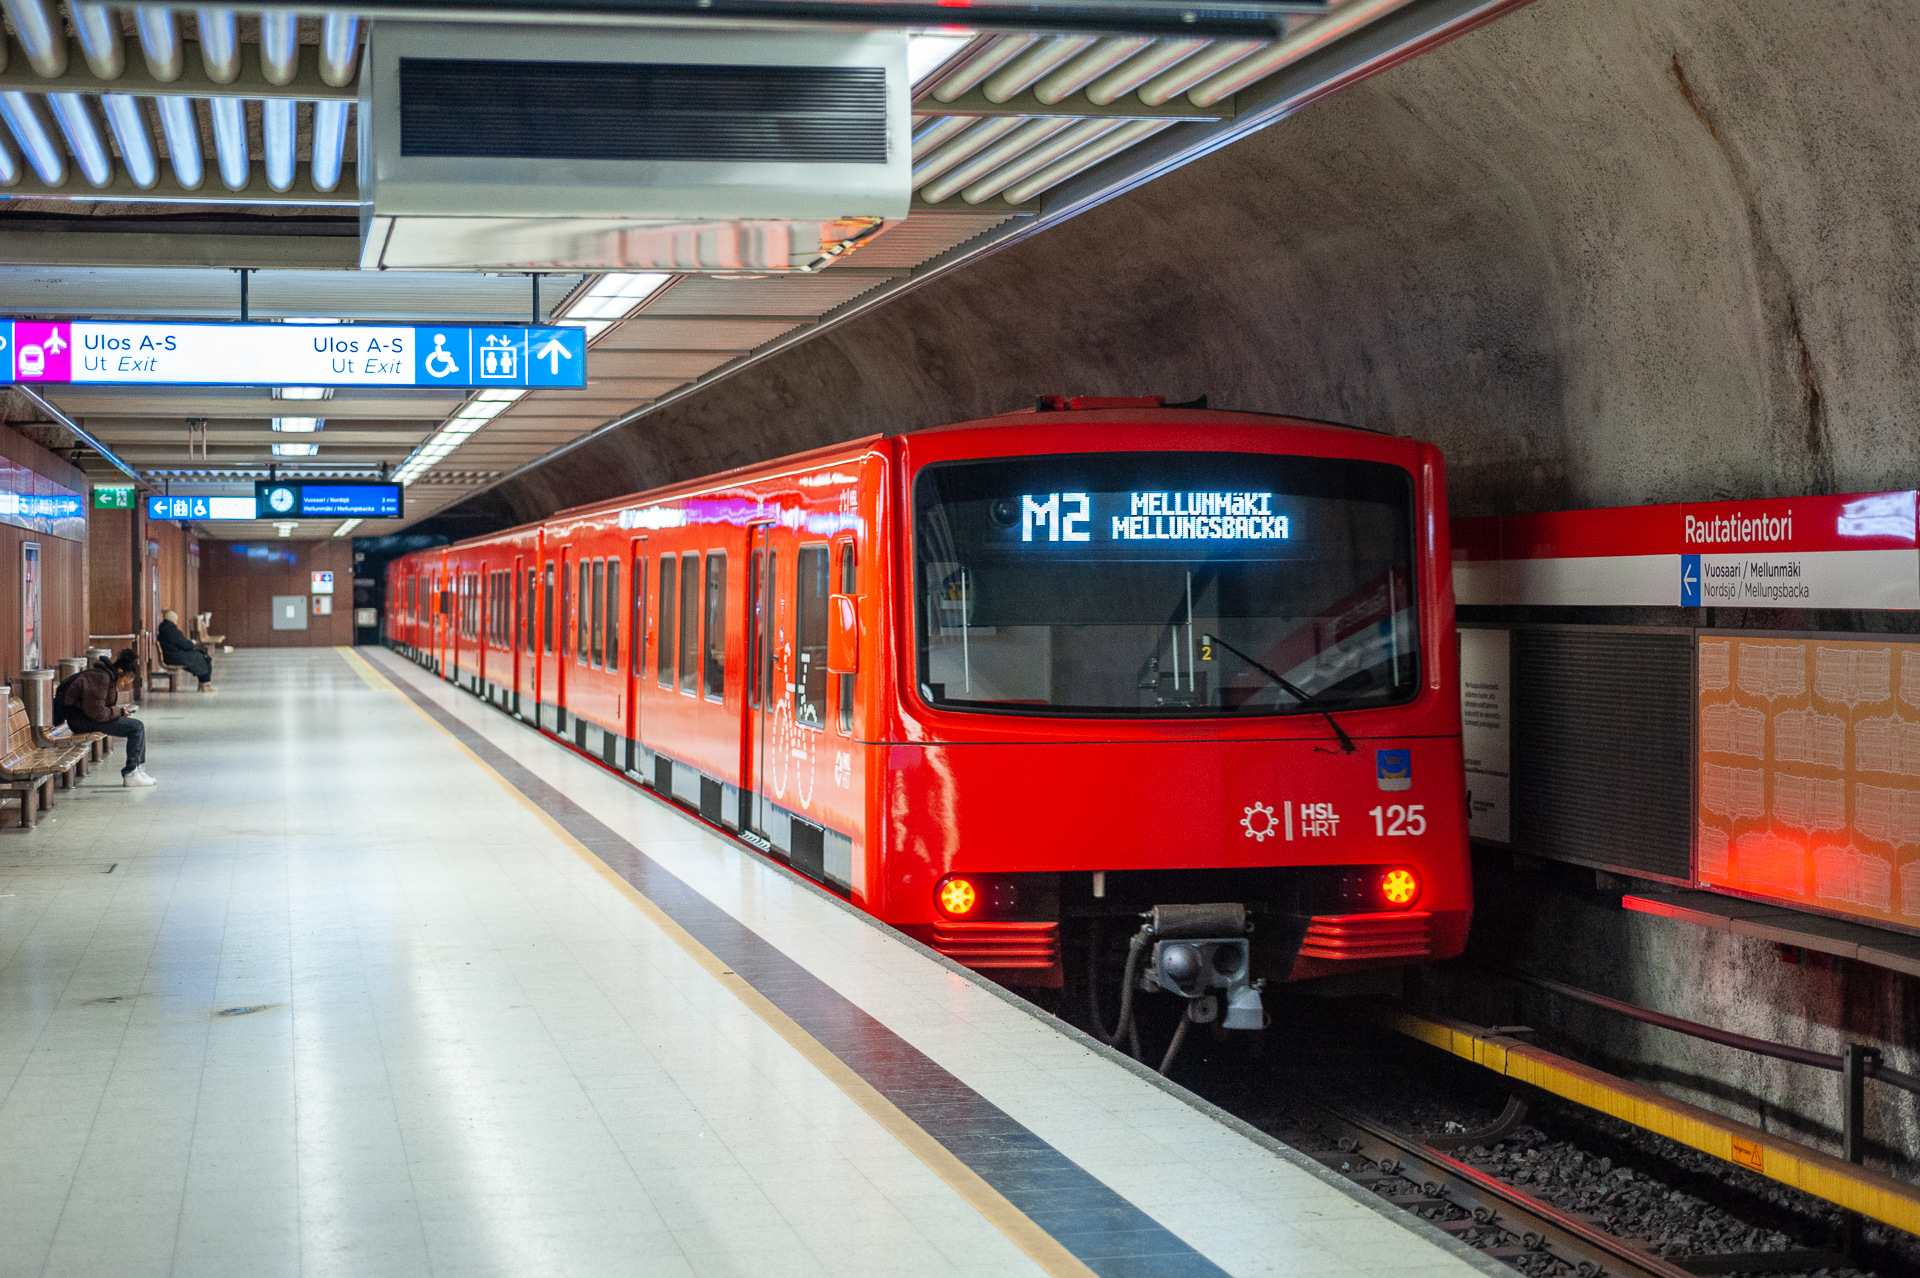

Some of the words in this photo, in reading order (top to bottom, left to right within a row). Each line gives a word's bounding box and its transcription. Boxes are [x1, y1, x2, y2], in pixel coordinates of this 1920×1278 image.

[84, 334, 131, 350] Ulos
[139, 335, 177, 351] A-S
[314, 337, 359, 353] Ulos
[367, 338, 403, 353] A-S
[84, 356, 107, 371] Ut
[118, 356, 158, 372] Exit
[332, 358, 354, 373] Ut
[364, 358, 403, 374] Exit
[1021, 492, 1091, 542] M2
[1111, 516, 1289, 539] MELLUNGSBACKA
[1685, 509, 1793, 543] Rautatientori
[1704, 562, 1741, 577] Vuosaari
[1750, 562, 1801, 578] Mellunmäki
[1703, 583, 1736, 600] Nordsjö
[1744, 582, 1810, 600] Mellungsbacka
[1201, 646, 1212, 661] 2
[1301, 803, 1340, 820] HSL
[1302, 820, 1340, 838] HRT
[1369, 804, 1427, 837] 125
